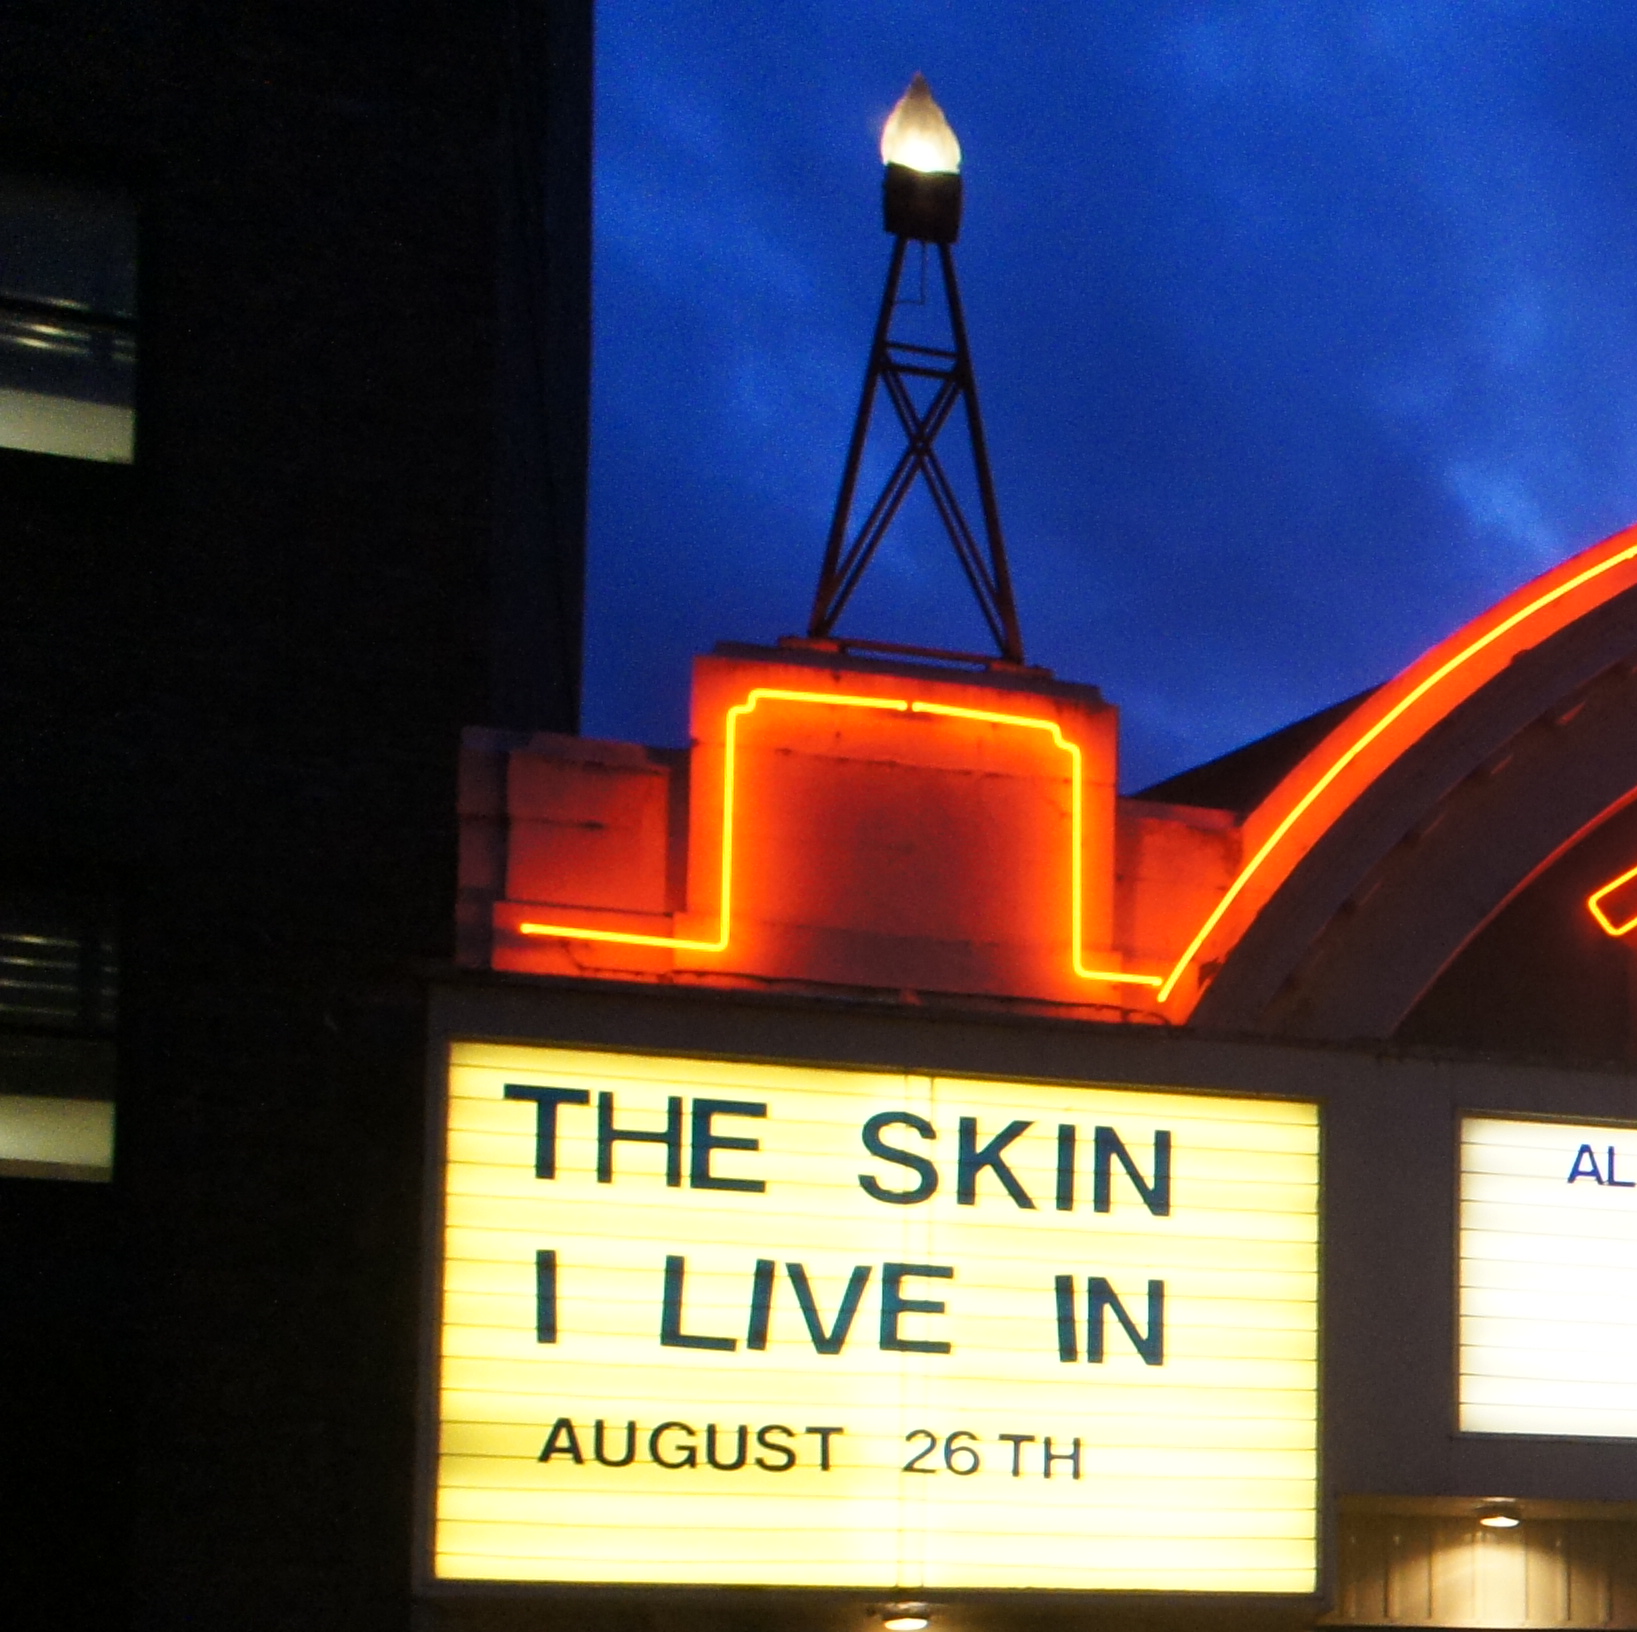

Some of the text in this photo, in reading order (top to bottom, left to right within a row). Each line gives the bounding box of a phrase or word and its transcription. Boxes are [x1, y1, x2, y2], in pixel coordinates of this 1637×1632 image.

[504, 1083, 1172, 1217] THE SKIN
[536, 1250, 1164, 1366] I LIVE IN
[538, 1417, 1082, 1480] AUGUST 26TH
